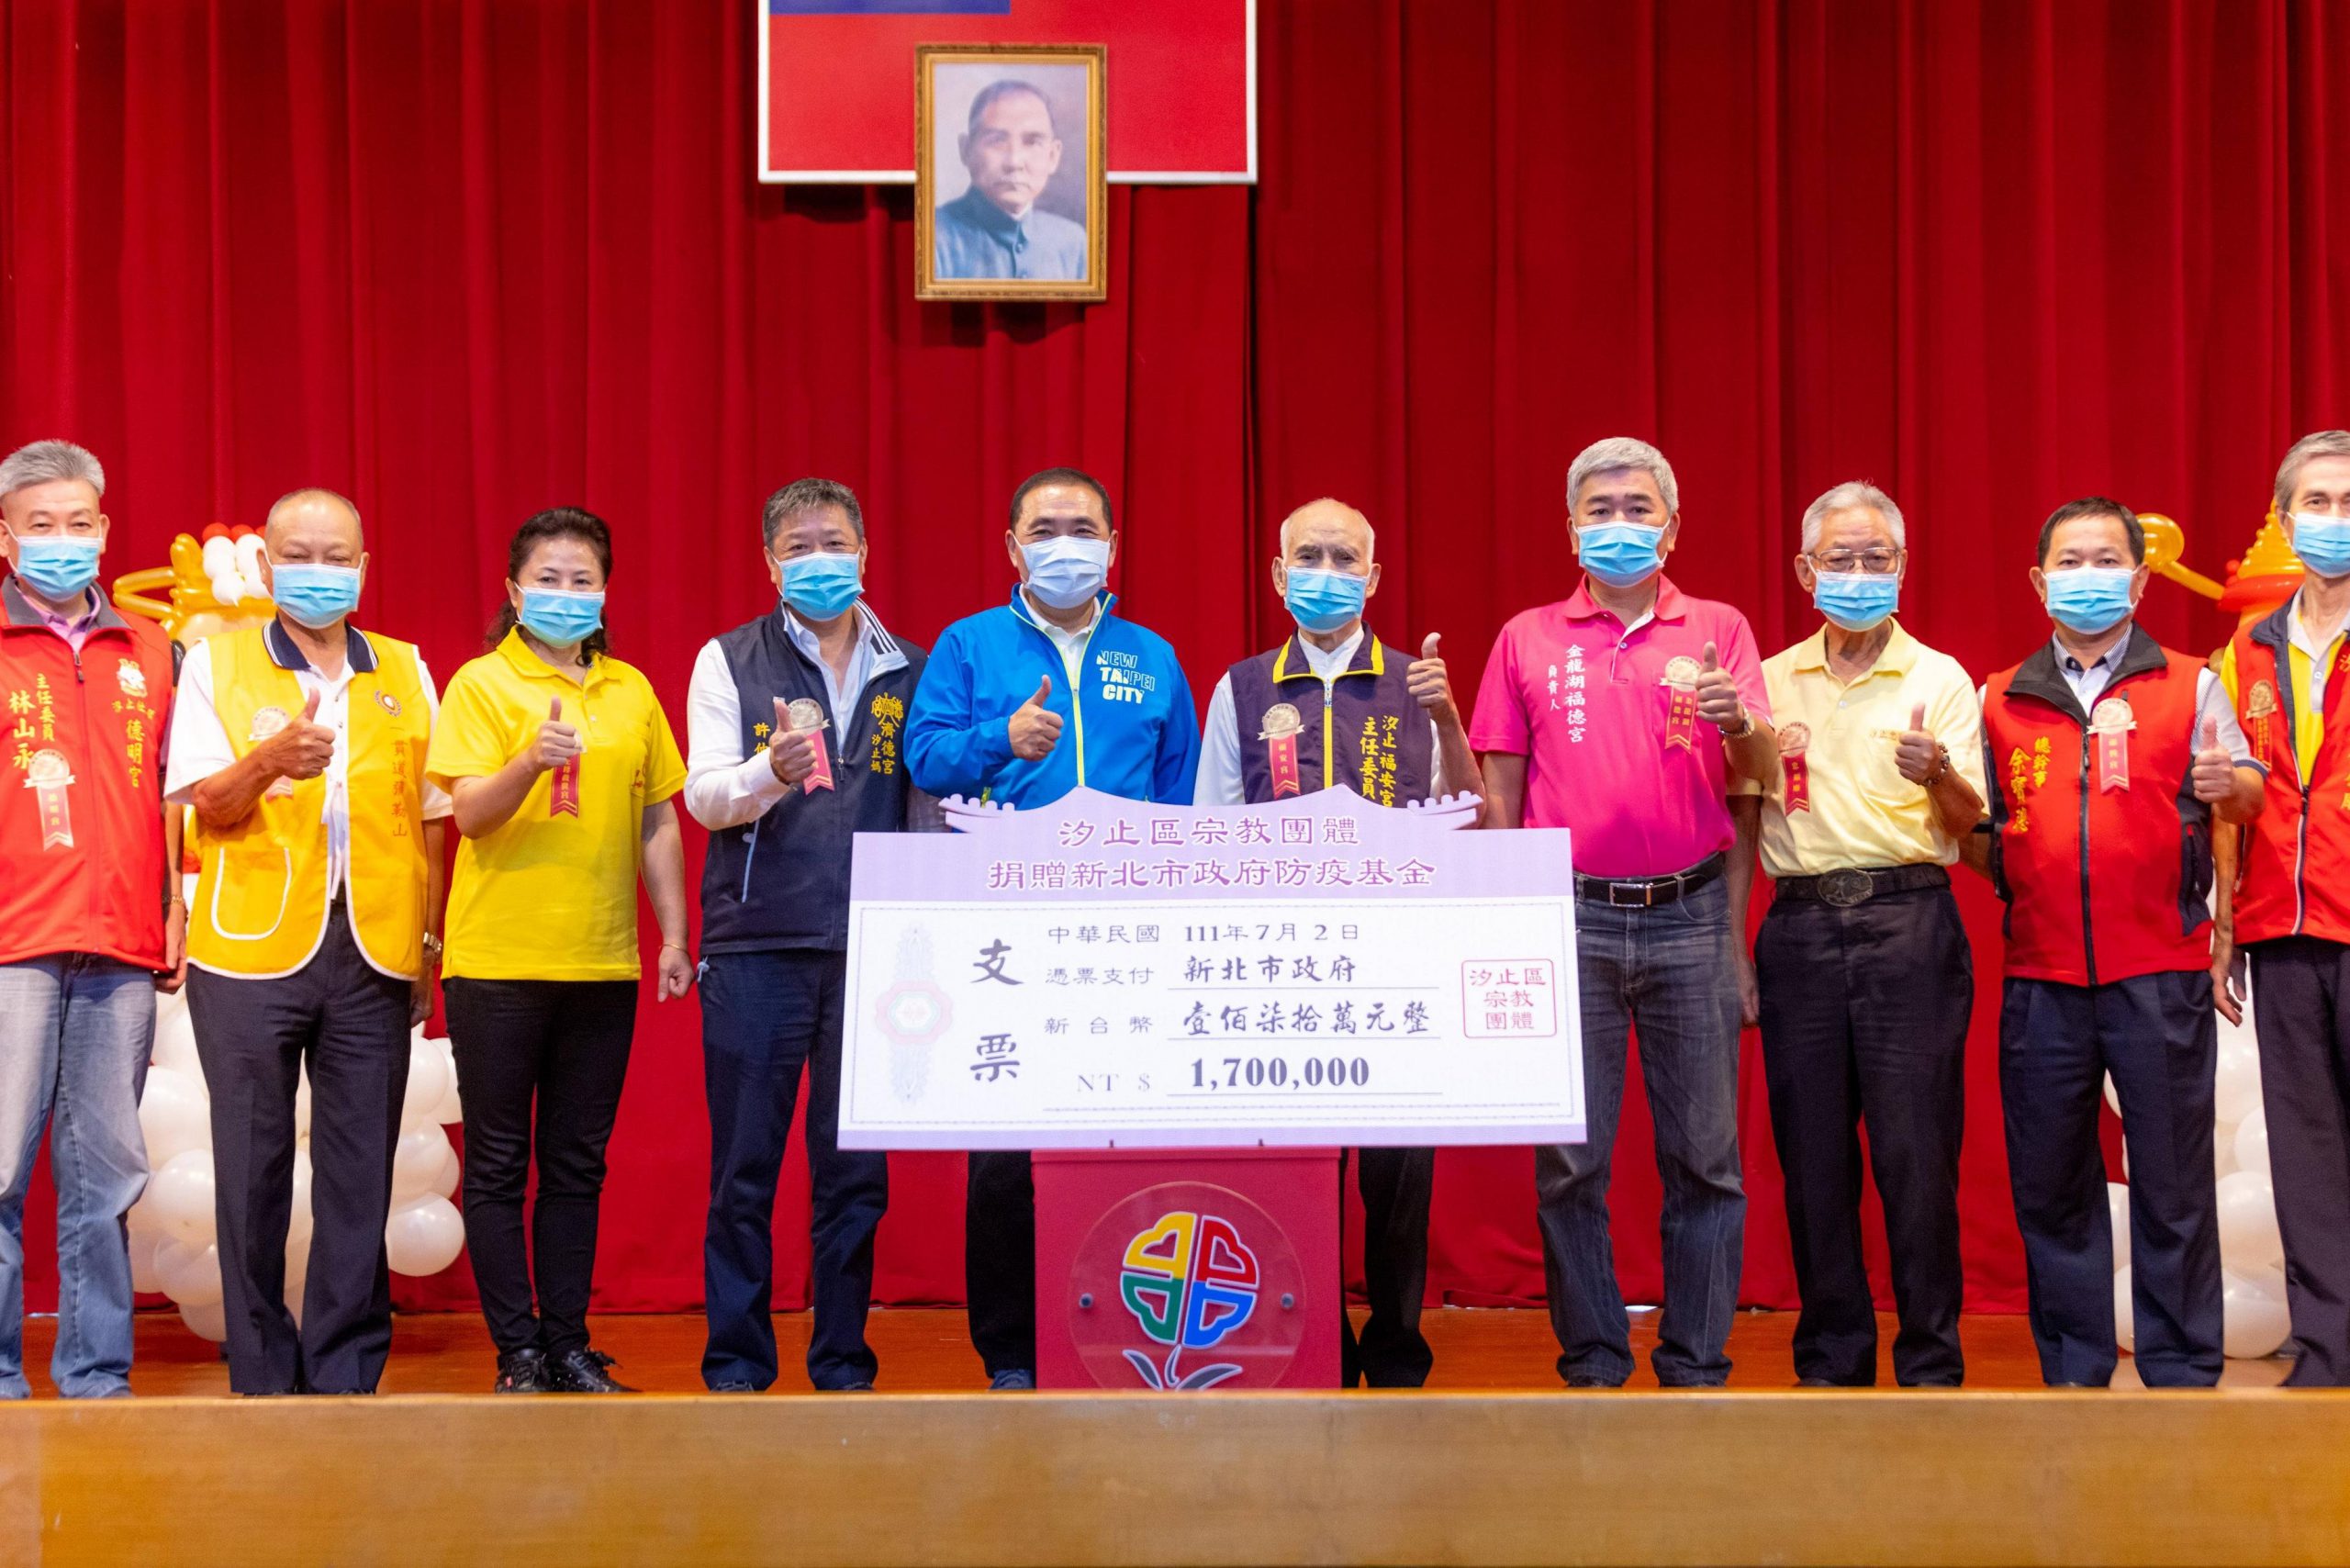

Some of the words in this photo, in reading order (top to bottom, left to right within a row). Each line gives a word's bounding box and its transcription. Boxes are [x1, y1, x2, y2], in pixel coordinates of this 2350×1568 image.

[1096, 650, 1138, 669] NEW
[1100, 666, 1156, 692] TAIPEI
[1102, 684, 1145, 704] CITY
[1547, 664, 1561, 711] 負責人
[1564, 644, 1586, 744] 金龍湖福德宮
[37, 673, 56, 742] 主任委員
[1359, 716, 1379, 800] 主任委員
[1379, 715, 1399, 808] 汐止福安宮
[1058, 817, 1360, 846] 汐止區宗教團體
[987, 858, 1436, 890] 捐贈新北市政府防疫基金
[1048, 924, 1159, 944] 中華民國
[1045, 967, 1155, 985] 憑票支付
[1183, 955, 1356, 983] 新北市政府
[1469, 968, 1547, 987] 汐止區
[1483, 990, 1534, 1008] 宗教
[1182, 1000, 1429, 1036] 壹佰柒拾萬元整
[1485, 1011, 1536, 1030] 團體
[1077, 1072, 1120, 1092] NT
[1191, 1057, 1370, 1091] 1,700,000
